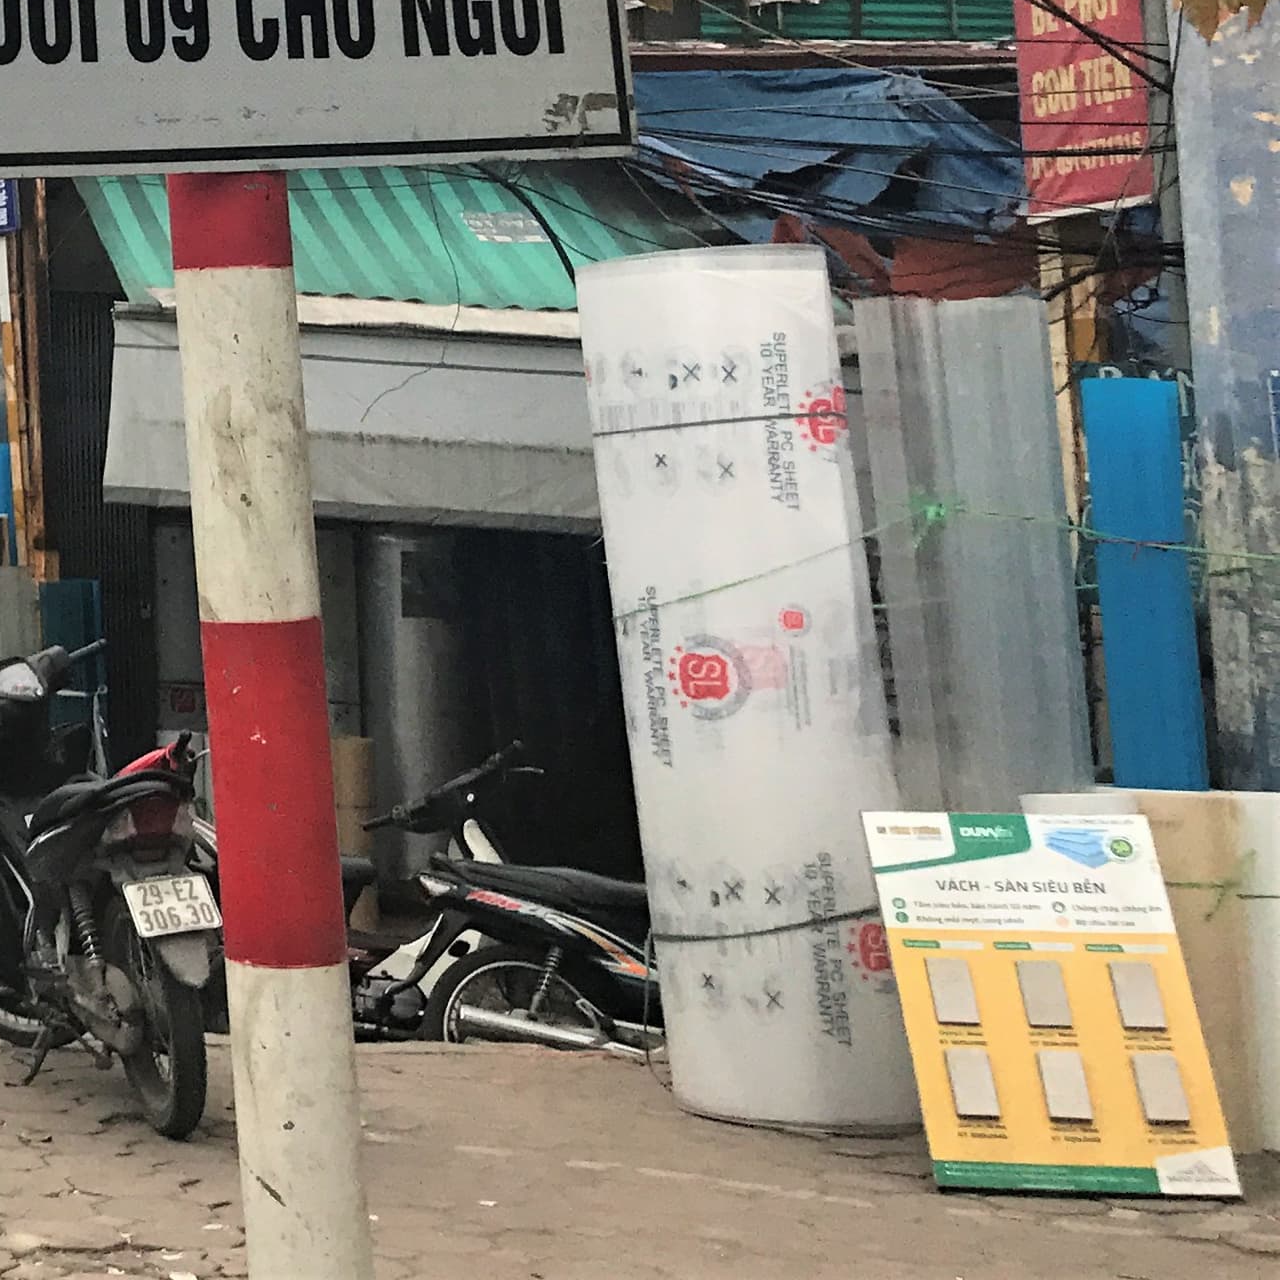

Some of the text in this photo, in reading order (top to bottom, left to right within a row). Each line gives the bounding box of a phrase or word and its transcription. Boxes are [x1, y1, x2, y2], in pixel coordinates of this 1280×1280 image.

[760, 342, 784, 503] 10 YEAR WARRANTY
[773, 332, 800, 511] SUPERLET PC SHEET
[640, 621, 652, 661] YEAR
[654, 686, 667, 707] PC
[687, 658, 724, 695] SL
[643, 670, 660, 758] WARRANTY
[659, 716, 673, 768] SHEET
[936, 878, 980, 892] VÁCH
[1032, 878, 1068, 894] SIÊU
[1073, 878, 1106, 894] BỀN
[139, 903, 215, 932] 306.30
[804, 863, 818, 880] 10
[813, 943, 834, 1037] WARRANTY
[830, 959, 844, 982] PC
[833, 991, 852, 1047] SHEET
